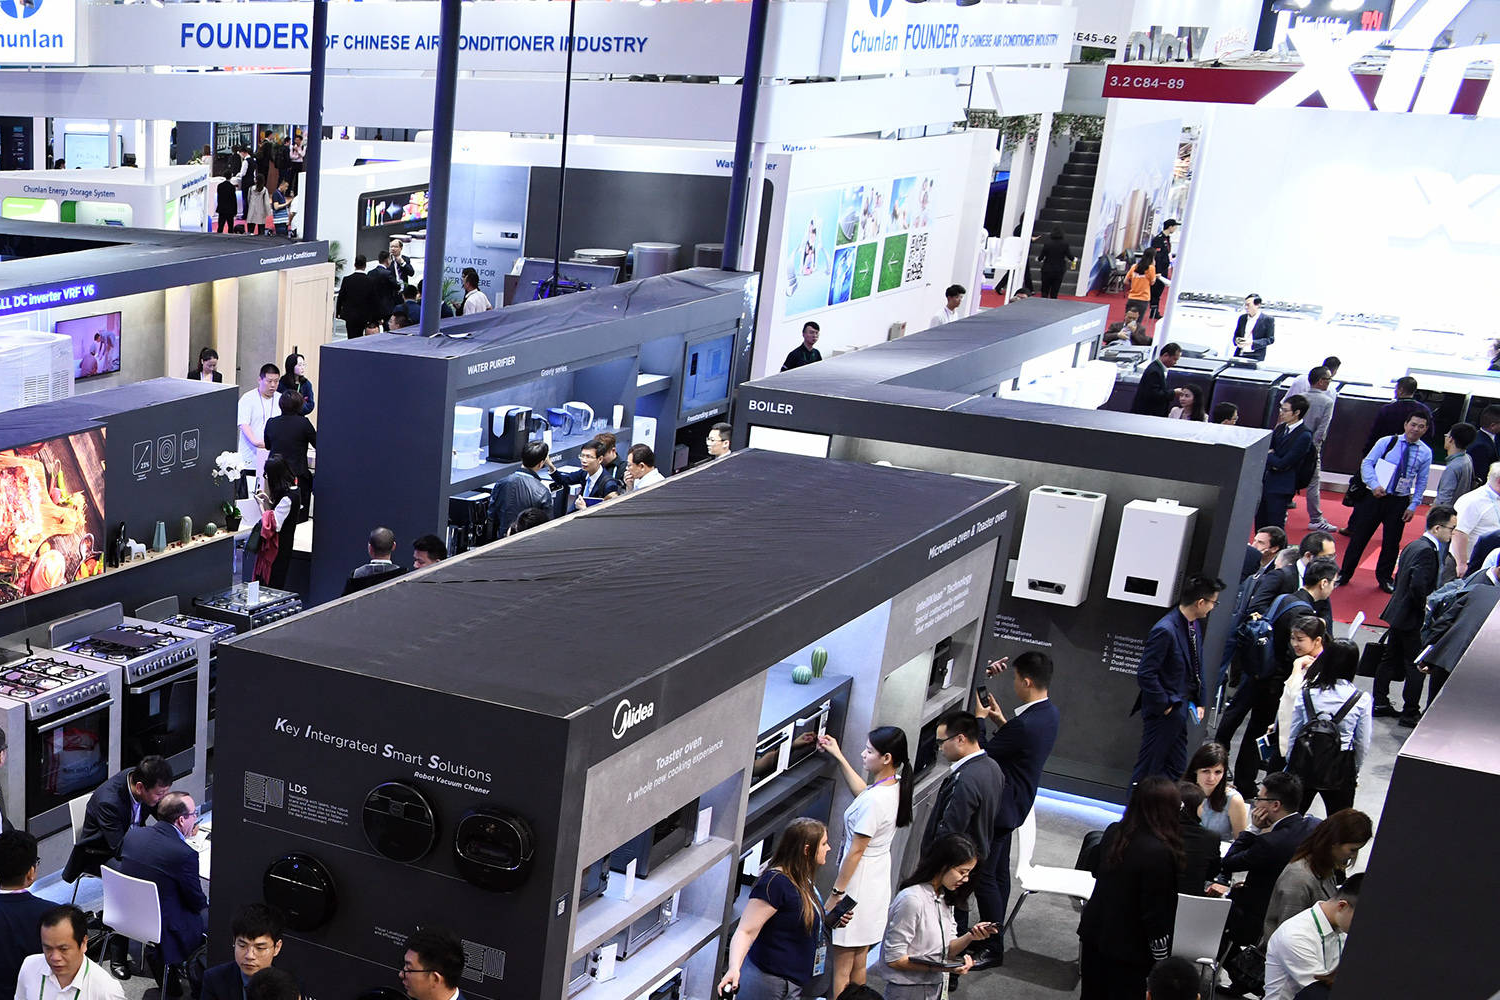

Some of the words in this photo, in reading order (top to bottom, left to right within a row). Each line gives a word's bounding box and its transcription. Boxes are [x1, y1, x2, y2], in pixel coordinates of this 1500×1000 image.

[180, 22, 309, 49] FOUNDER
[343, 34, 411, 51] CHINESE
[414, 35, 441, 51] AIR
[457, 35, 555, 52] ONDITIONER
[564, 36, 648, 53] INDUSTRY
[851, 29, 898, 53] Chunlan
[904, 23, 959, 50] FOUNDER
[1110, 76, 1130, 88] 3.2
[1133, 77, 1185, 90] C84-89
[23, 185, 47, 194] Chunlan
[49, 186, 69, 197] Energy
[70, 186, 92, 198] Storage
[93, 188, 116, 199] System
[260, 255, 285, 266] Commercial
[294, 251, 317, 262] Conditioner
[460, 257, 488, 265] WATER
[481, 269, 496, 277] FOR
[12, 292, 28, 309] DC
[27, 288, 63, 306] inverter
[63, 286, 81, 301] VRF
[82, 284, 95, 298] V6
[467, 361, 488, 376] WATER
[489, 355, 516, 371] PURIFIER
[749, 400, 794, 415] BOILER
[928, 536, 958, 560] Microwave
[957, 529, 970, 546] oven
[975, 515, 996, 536] Toaster
[995, 509, 1008, 526] oven
[1112, 652, 1124, 660] Two
[612, 699, 654, 739] Midea
[274, 717, 300, 737] Key
[304, 724, 377, 755] Intergrated
[382, 743, 423, 767] Smart
[427, 754, 492, 784] Solutions
[655, 743, 683, 771] Toaster
[684, 736, 703, 755] oven
[414, 770, 435, 783] Robot
[436, 776, 462, 790] Vacuum
[463, 782, 490, 796] Cleaner
[627, 791, 633, 804] A
[634, 781, 653, 800] whole
[653, 773, 667, 788] new
[667, 758, 693, 782] cooking
[692, 738, 724, 767] experience
[288, 782, 308, 796] LDS
